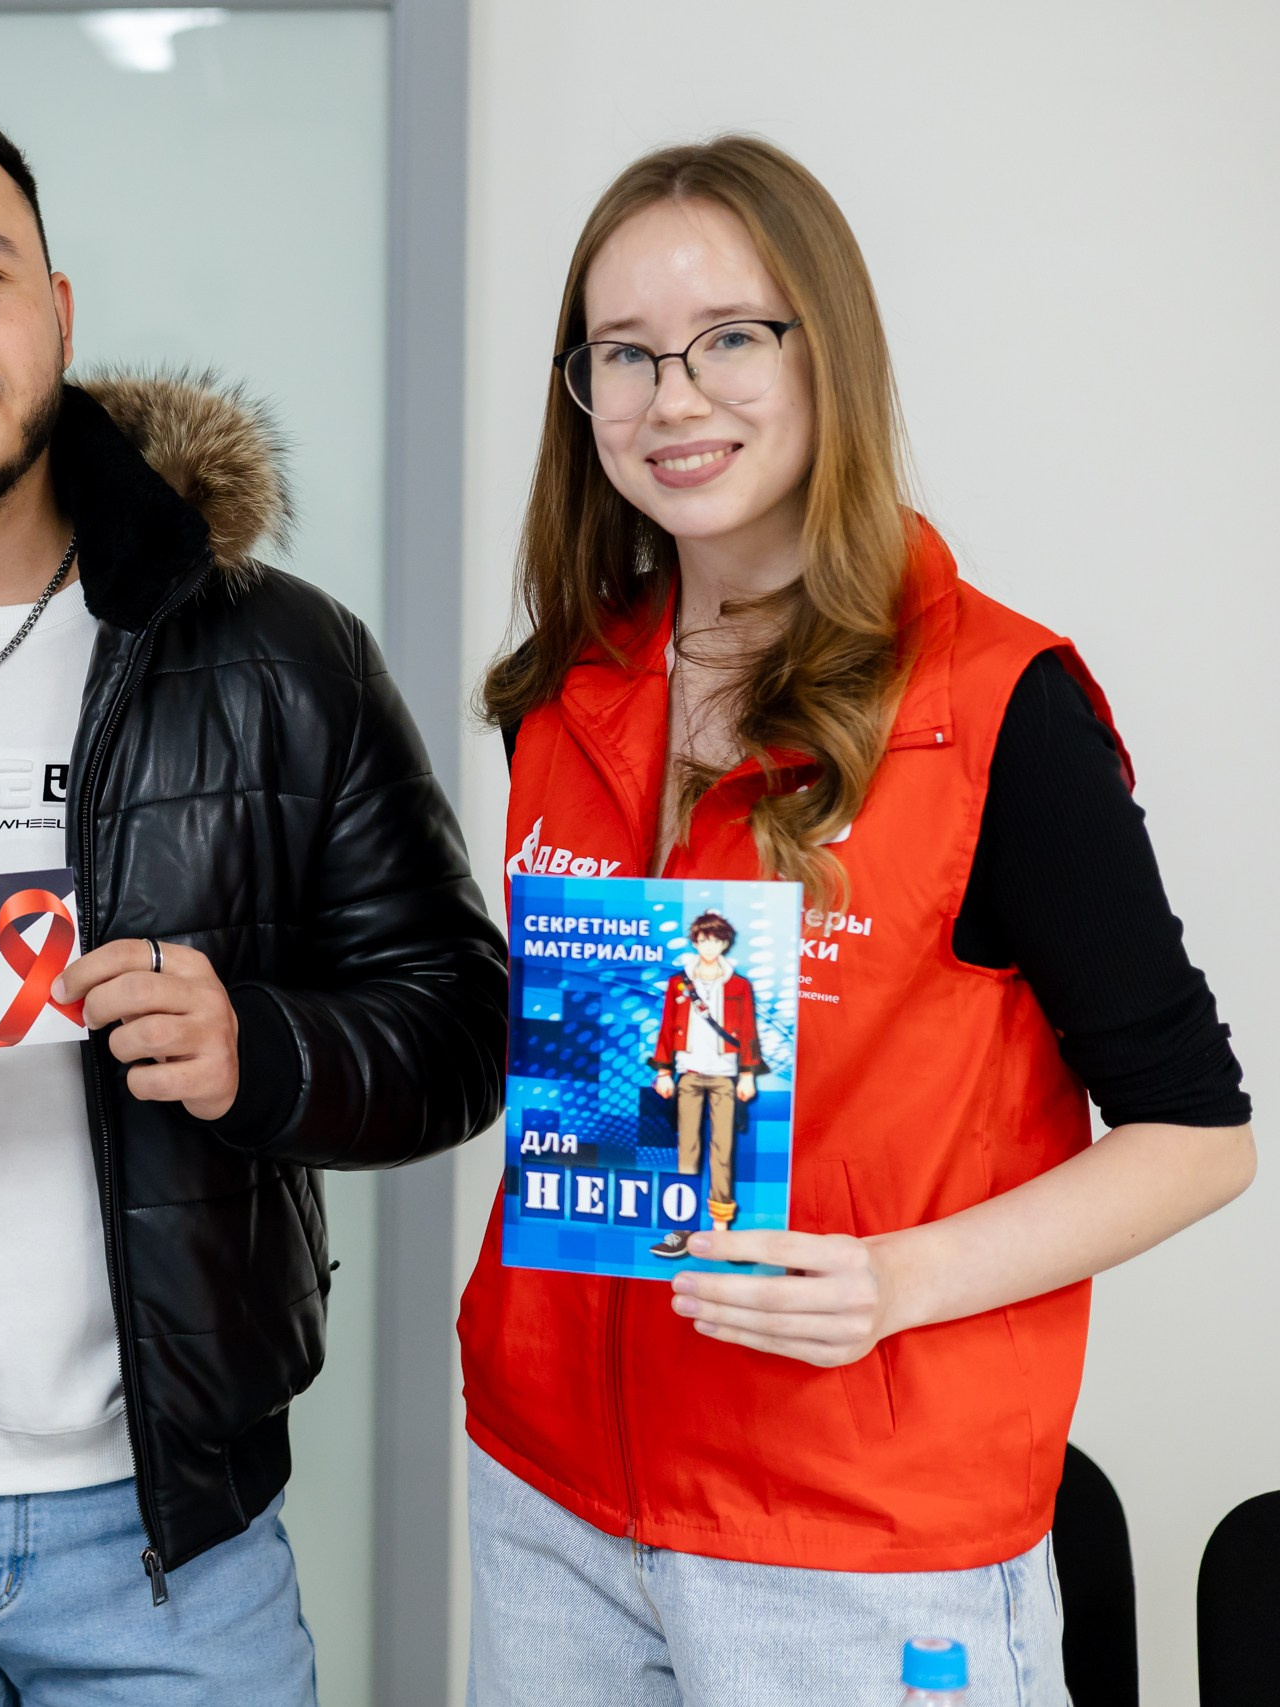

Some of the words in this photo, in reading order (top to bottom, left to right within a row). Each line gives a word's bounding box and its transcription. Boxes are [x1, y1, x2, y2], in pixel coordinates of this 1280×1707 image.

[532, 845, 622, 878] ДВФУ
[524, 914, 650, 936] СЕКРЕТНЫЕ
[800, 908, 872, 938] еры
[524, 939, 663, 962] МАТЕРИАЛЫ
[520, 1130, 578, 1156] ДЛЯ
[525, 1171, 698, 1223] НЕГО
